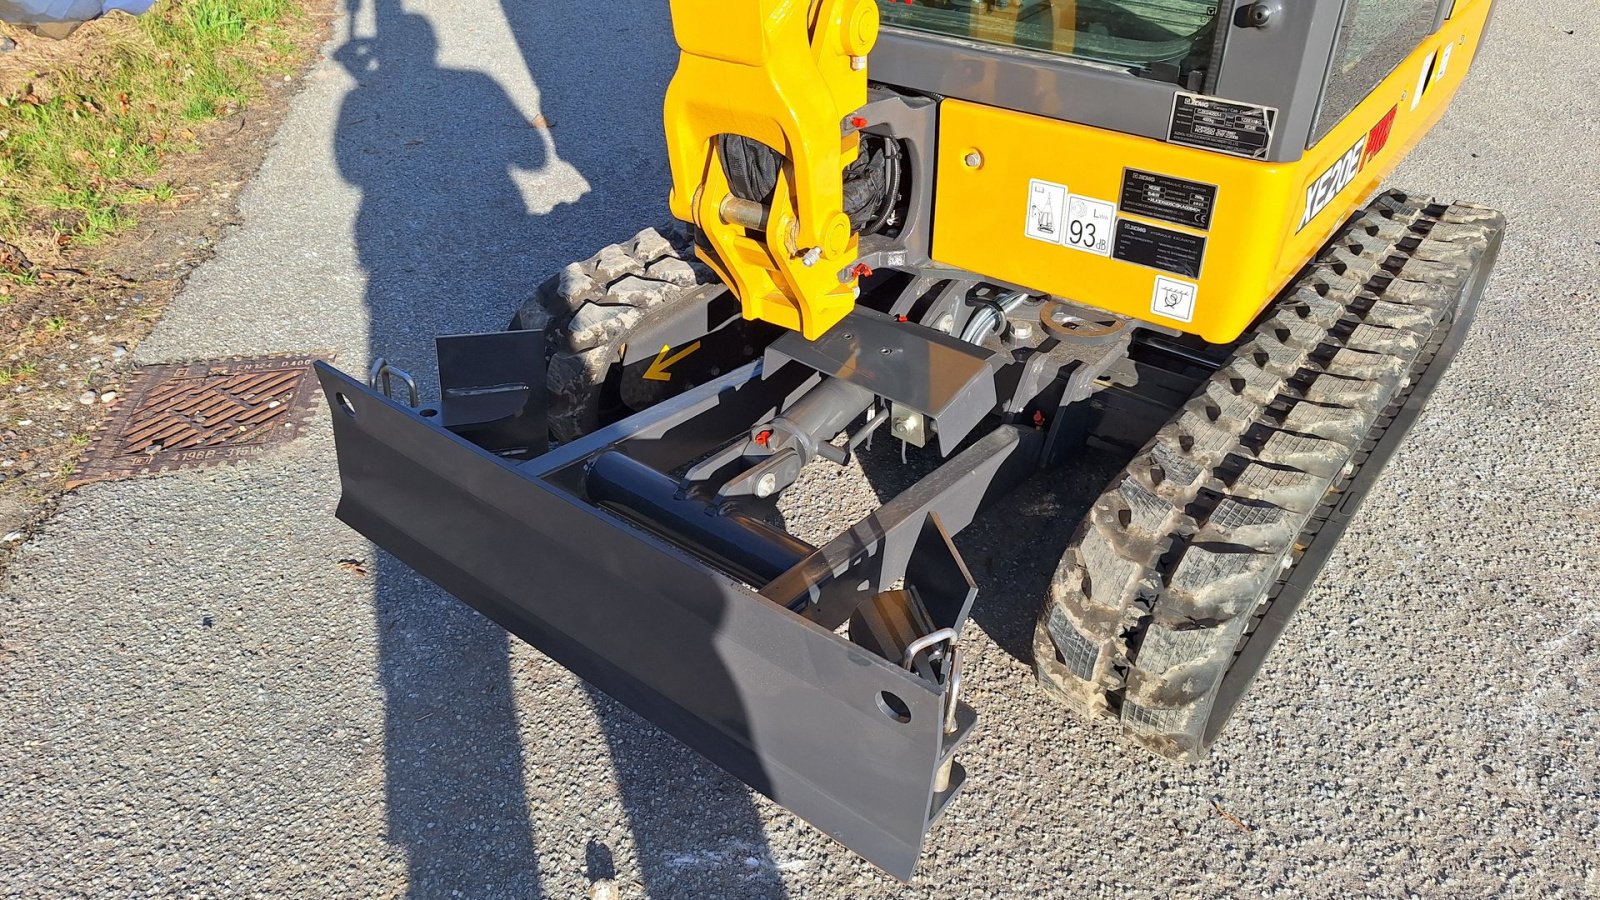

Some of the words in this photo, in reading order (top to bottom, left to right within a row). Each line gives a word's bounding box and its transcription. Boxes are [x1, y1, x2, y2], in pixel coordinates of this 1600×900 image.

[1295, 133, 1367, 236] XE20E
[1194, 213, 1207, 223] CE
[1069, 219, 1096, 248] 93
[1095, 238, 1107, 251] dB
